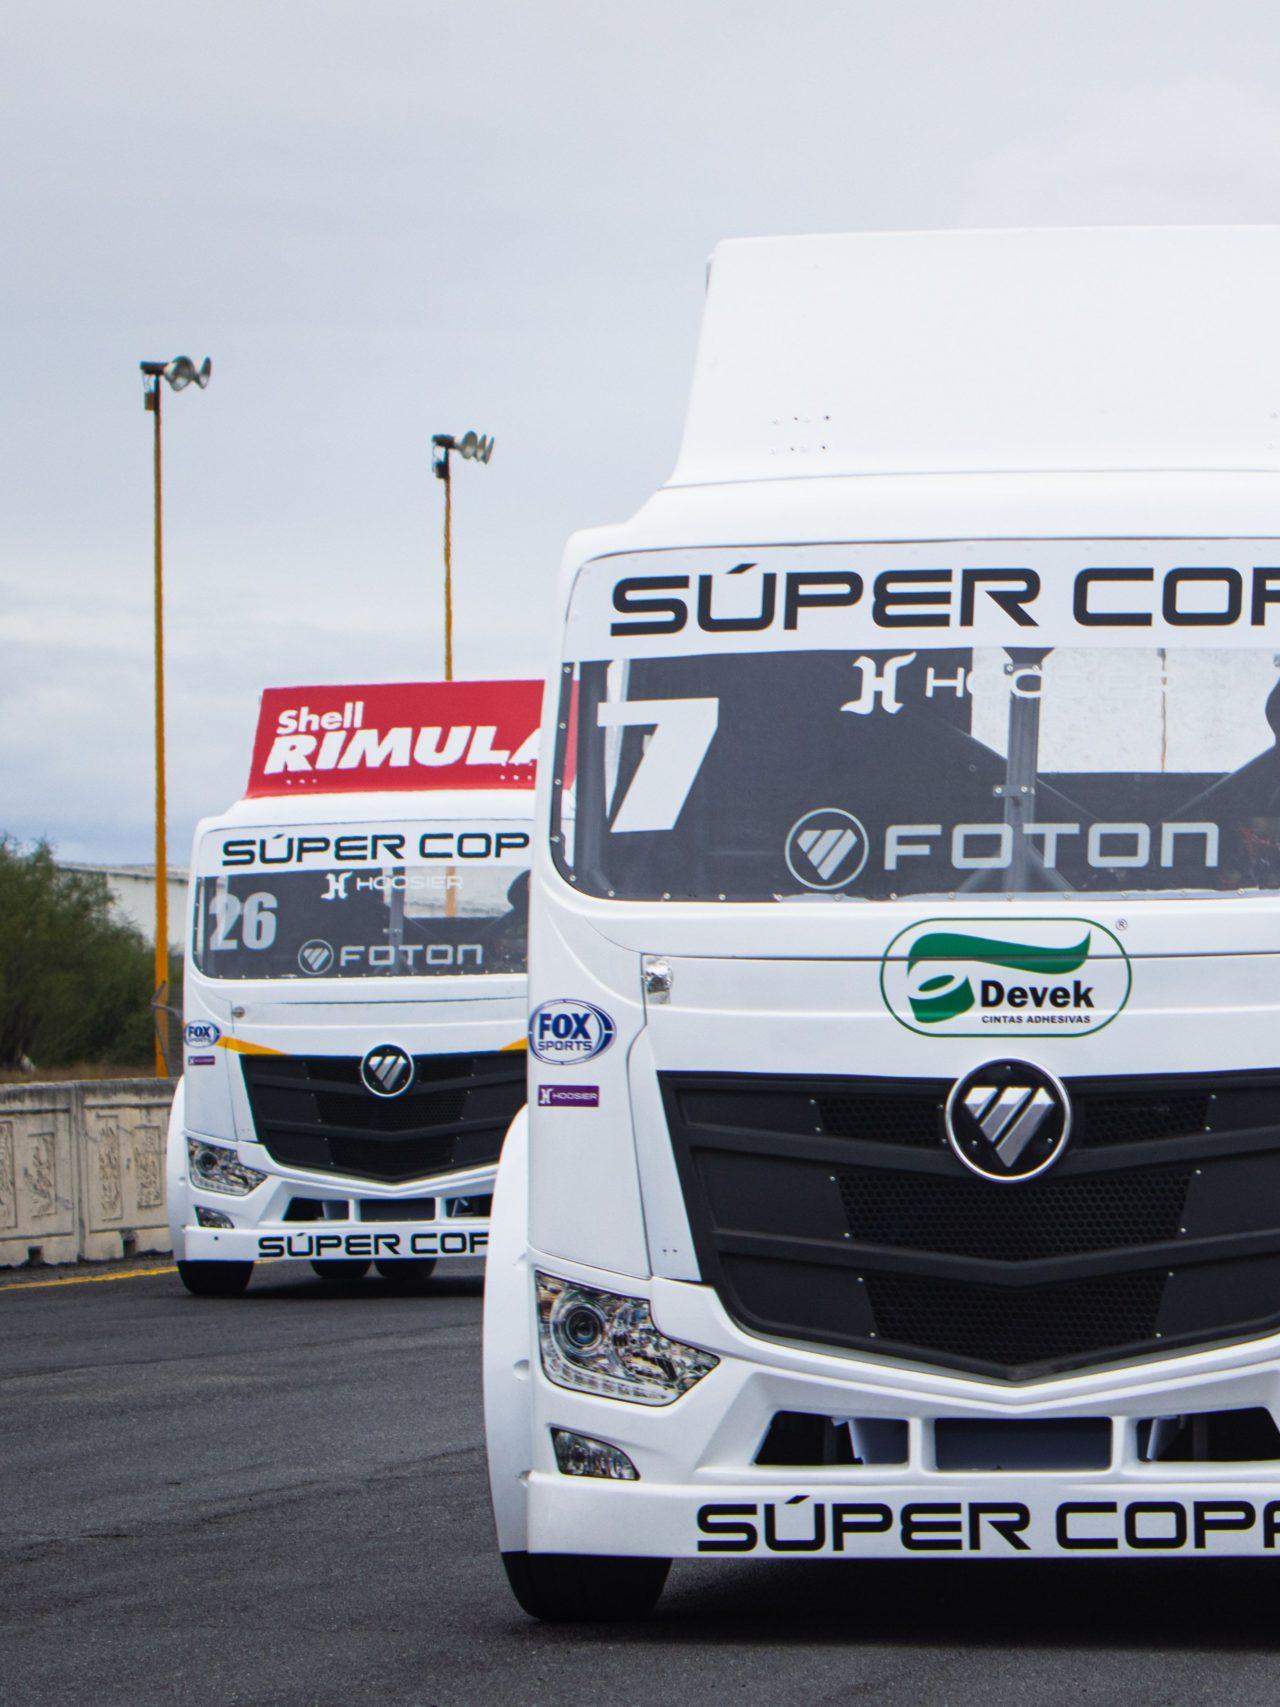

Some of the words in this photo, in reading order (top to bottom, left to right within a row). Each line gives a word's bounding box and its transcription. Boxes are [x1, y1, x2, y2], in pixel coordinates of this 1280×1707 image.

[610, 563, 1040, 637] SÚPER
[276, 701, 364, 734] Shell
[597, 697, 719, 833] 7
[222, 834, 405, 866] SÚPER
[419, 832, 530, 859] COP
[884, 822, 1219, 871] FOTON
[356, 876, 464, 891] HOOSIER
[209, 892, 278, 952] 26
[340, 944, 483, 967] FOTON
[980, 980, 1095, 1008] Devek
[188, 1026, 210, 1037] FOX
[538, 1013, 592, 1040] FOX
[981, 1015, 1023, 1024] CINTAS
[1027, 1015, 1091, 1024] ADHESIVAS
[538, 1041, 593, 1051] SPORTS
[258, 1233, 401, 1258] SÚPER
[410, 1232, 489, 1255] COP
[697, 1495, 1031, 1551] SÚPER
